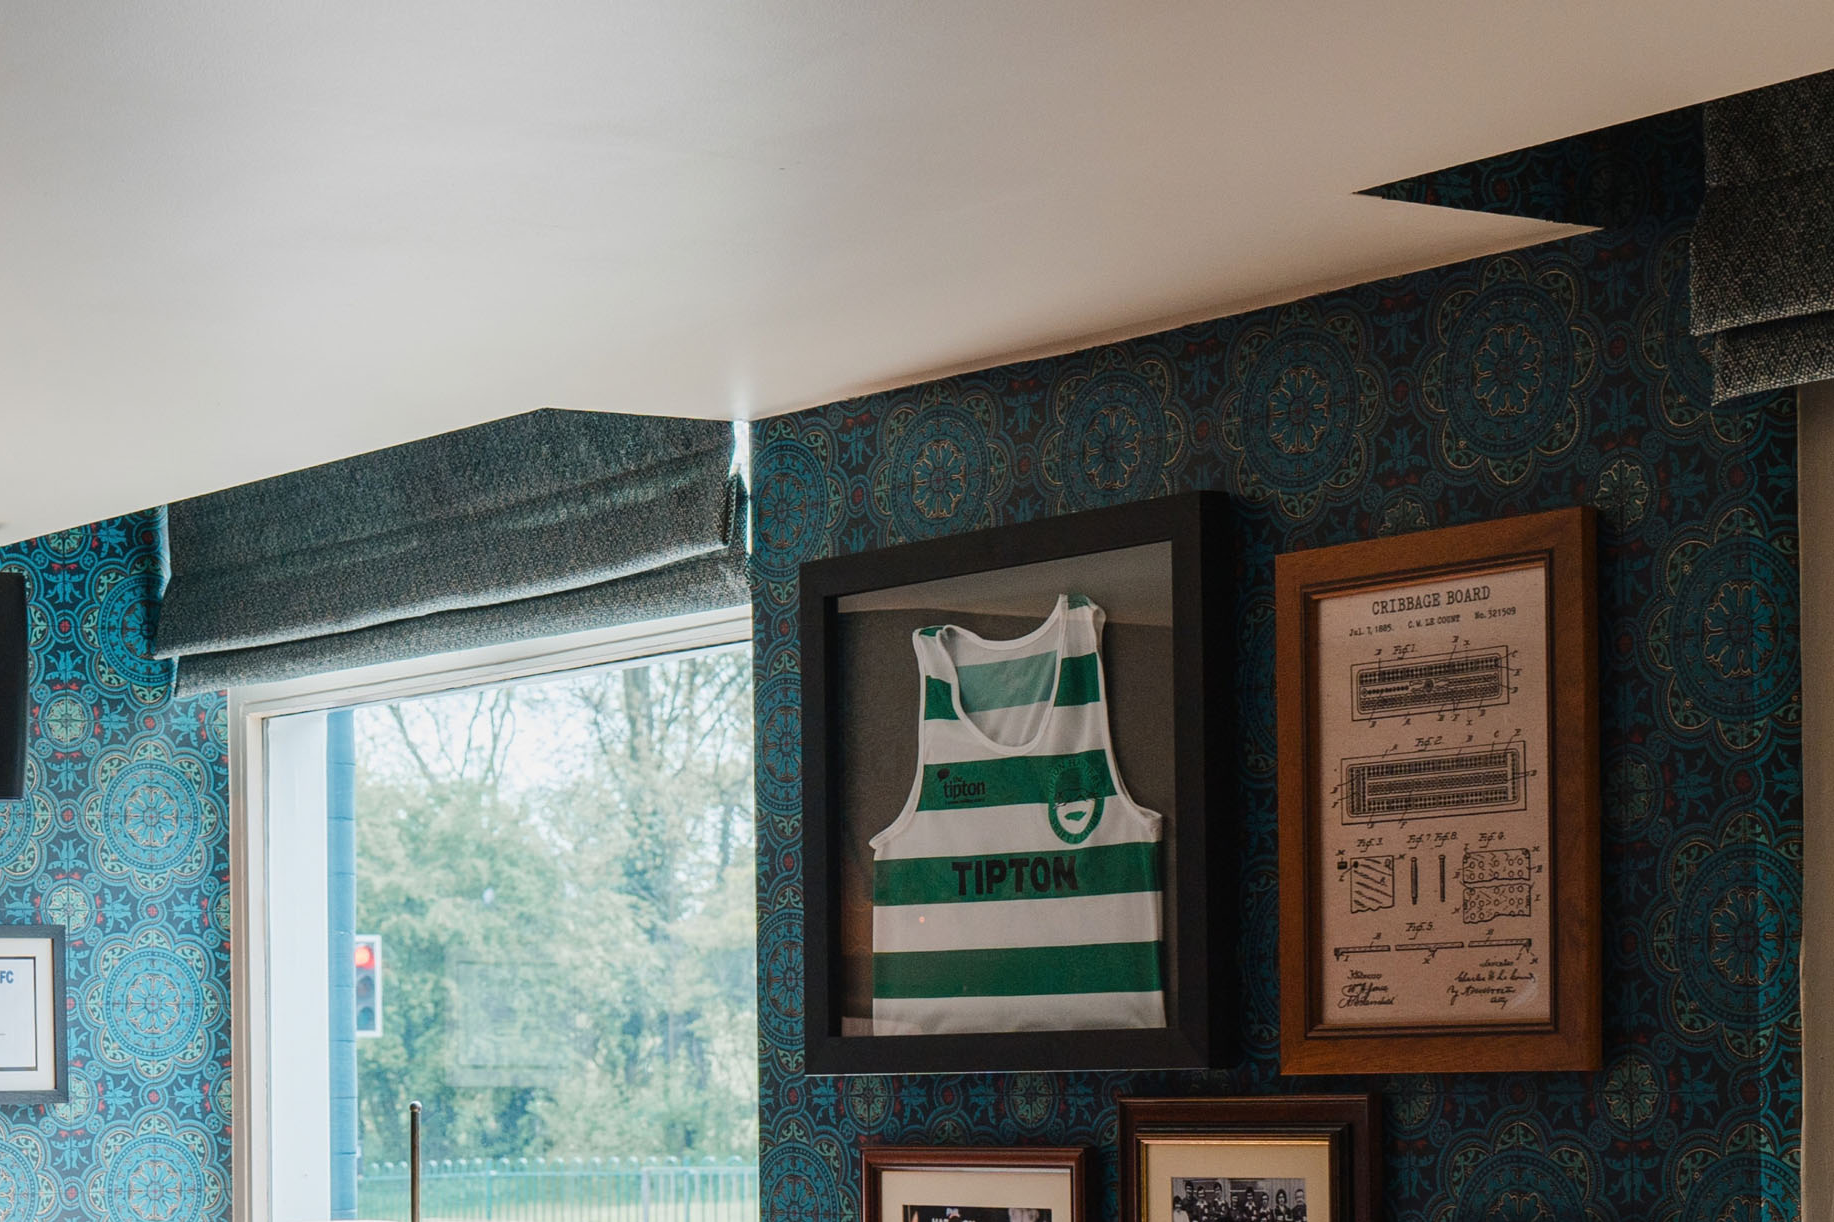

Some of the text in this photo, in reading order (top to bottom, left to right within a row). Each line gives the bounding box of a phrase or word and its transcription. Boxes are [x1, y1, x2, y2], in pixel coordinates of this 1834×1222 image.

[1371, 585, 1491, 616] CRIBBAGE BOARD
[1437, 614, 1461, 625] COUNT
[1487, 606, 1516, 619] 321509
[944, 780, 986, 800] tipton
[951, 856, 1079, 897] TIPTON
[0, 970, 14, 984] FC
